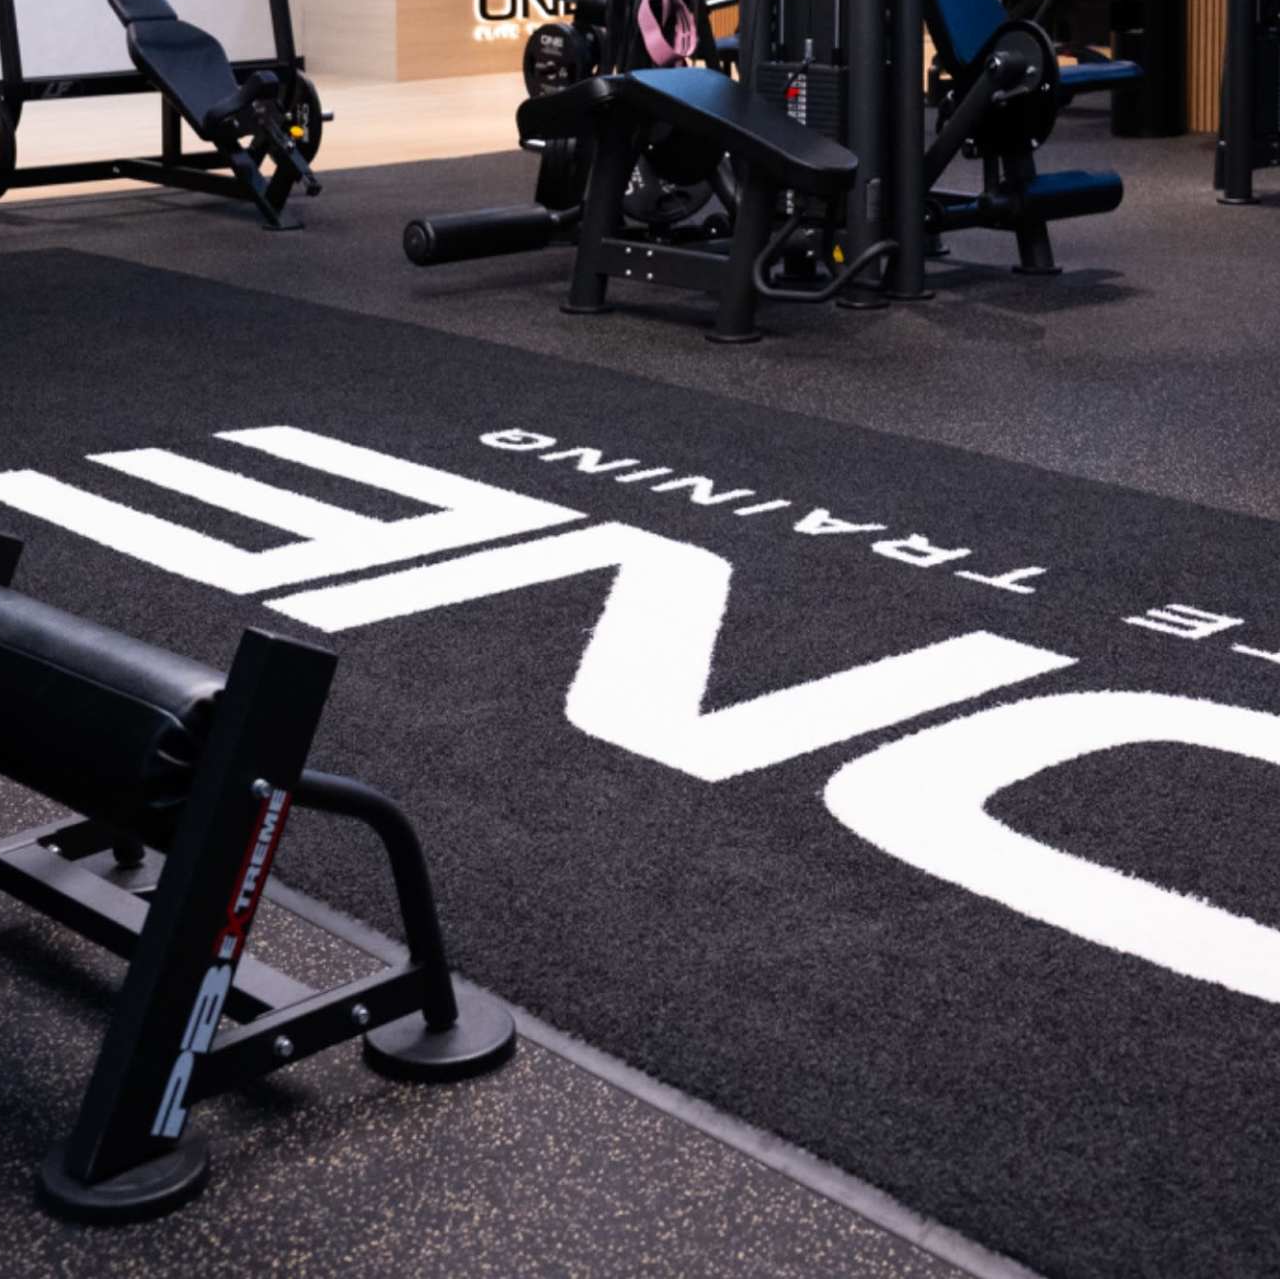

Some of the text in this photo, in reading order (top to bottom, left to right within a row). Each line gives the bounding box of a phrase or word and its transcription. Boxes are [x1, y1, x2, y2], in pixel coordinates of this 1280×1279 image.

[477, 427, 1052, 595] TRAINING
[149, 788, 292, 1139] PB EXTREME
